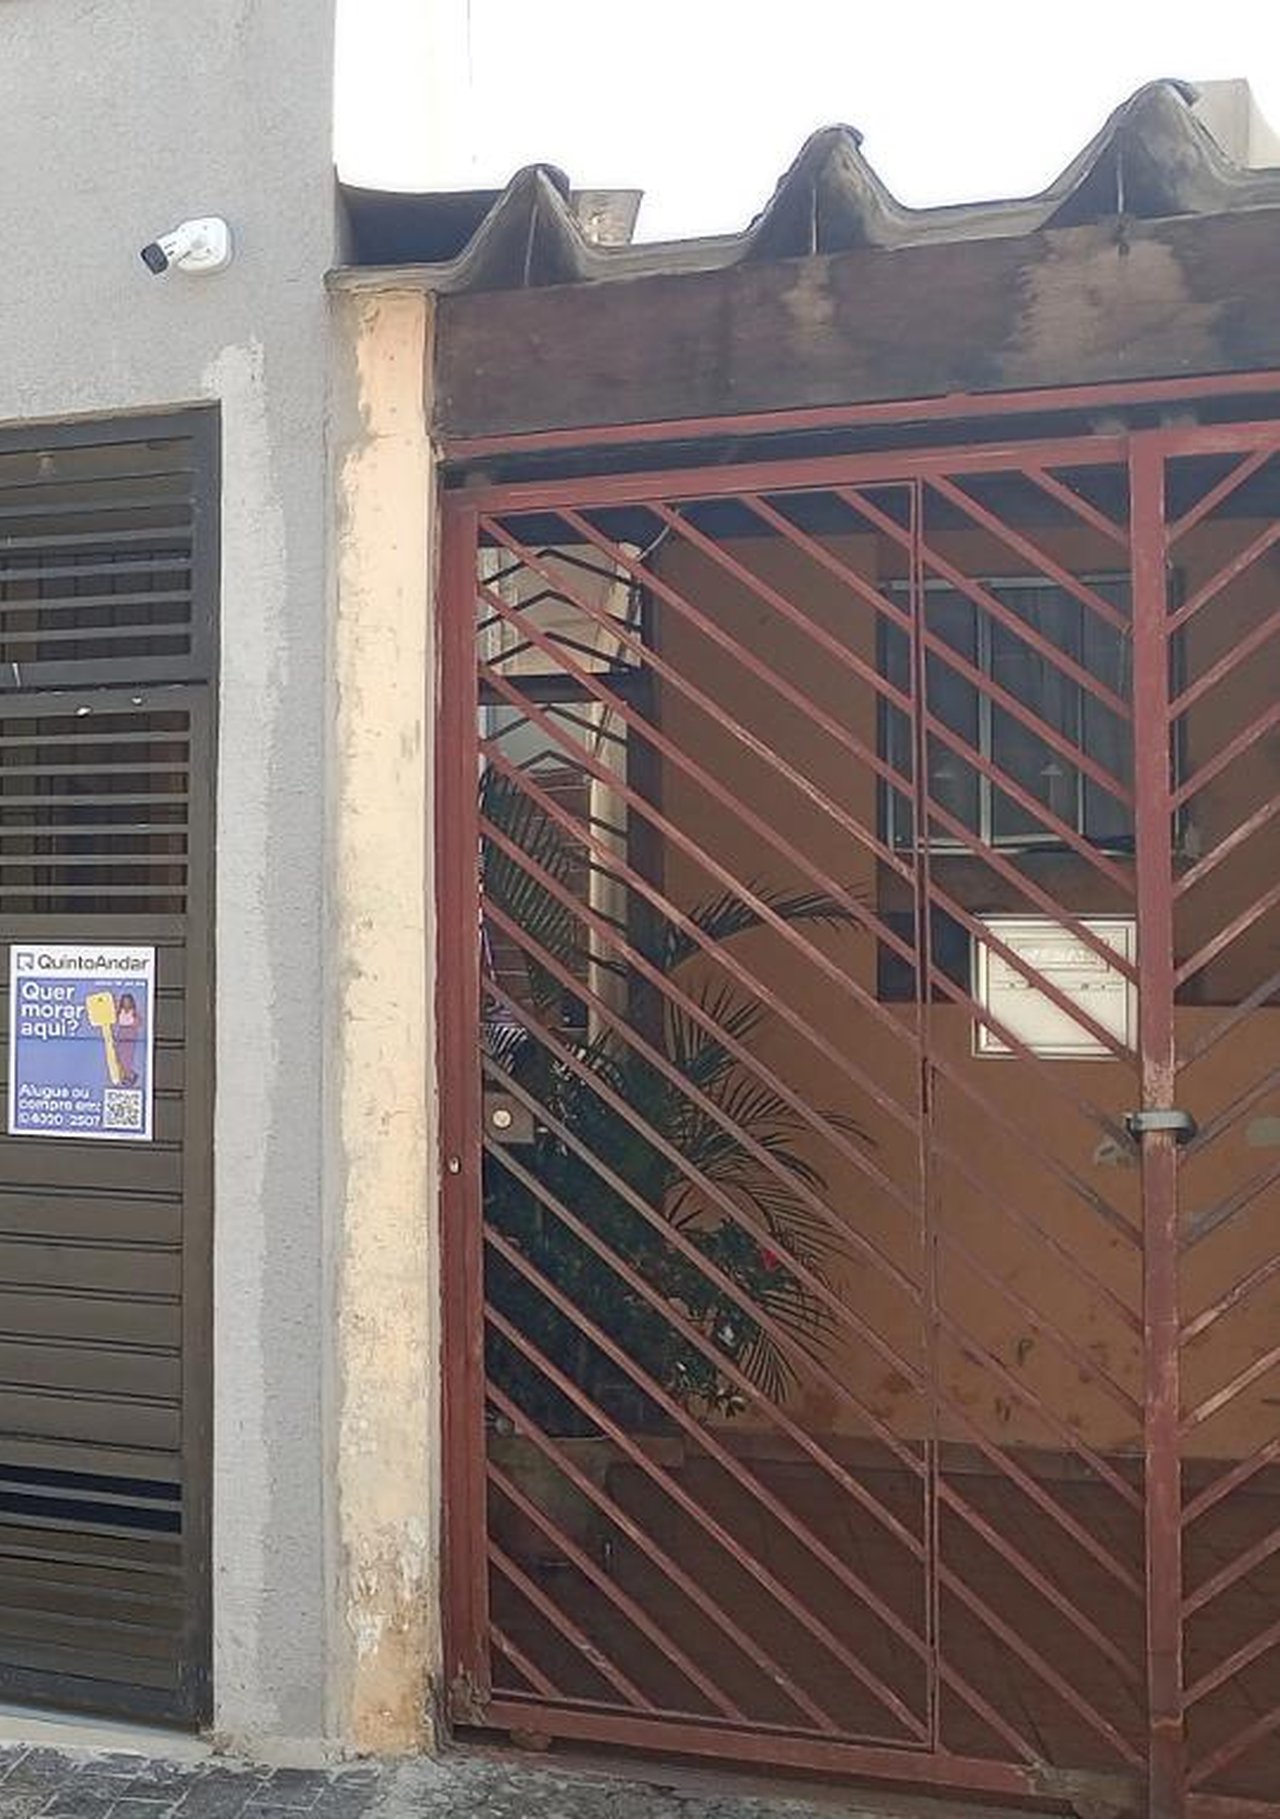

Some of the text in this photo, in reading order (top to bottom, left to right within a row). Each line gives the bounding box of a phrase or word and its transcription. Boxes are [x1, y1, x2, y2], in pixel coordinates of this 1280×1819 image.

[38, 954, 150, 971] QuintoAndar
[22, 982, 75, 1000] Quer
[21, 1003, 85, 1018] morar
[21, 1019, 79, 1040] aqui?
[72, 1088, 89, 1099] ou
